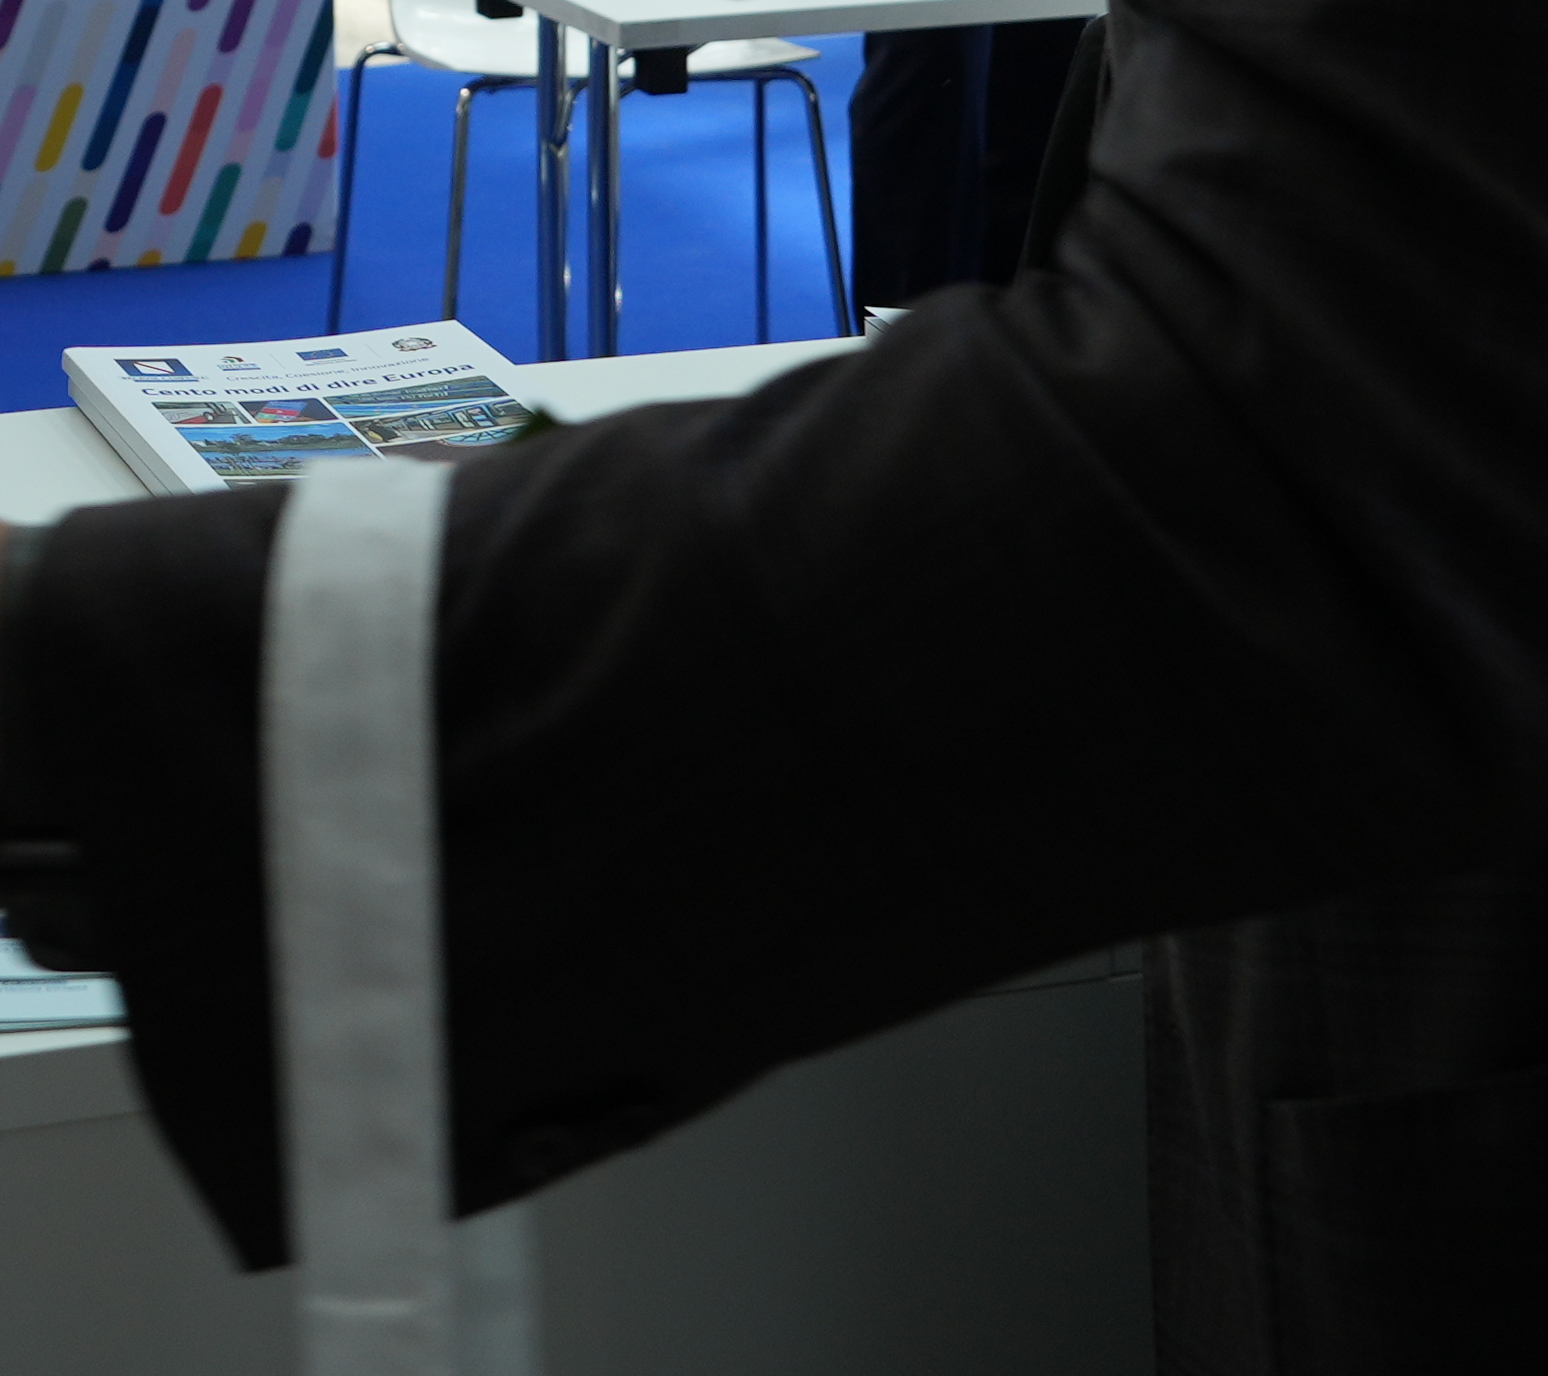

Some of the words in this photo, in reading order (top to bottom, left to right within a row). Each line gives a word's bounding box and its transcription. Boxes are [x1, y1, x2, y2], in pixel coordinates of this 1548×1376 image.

[140, 386, 218, 398] Cento
[223, 384, 292, 397] modi
[295, 380, 322, 393] di
[325, 375, 379, 389] dire
[382, 362, 477, 383] Europa
